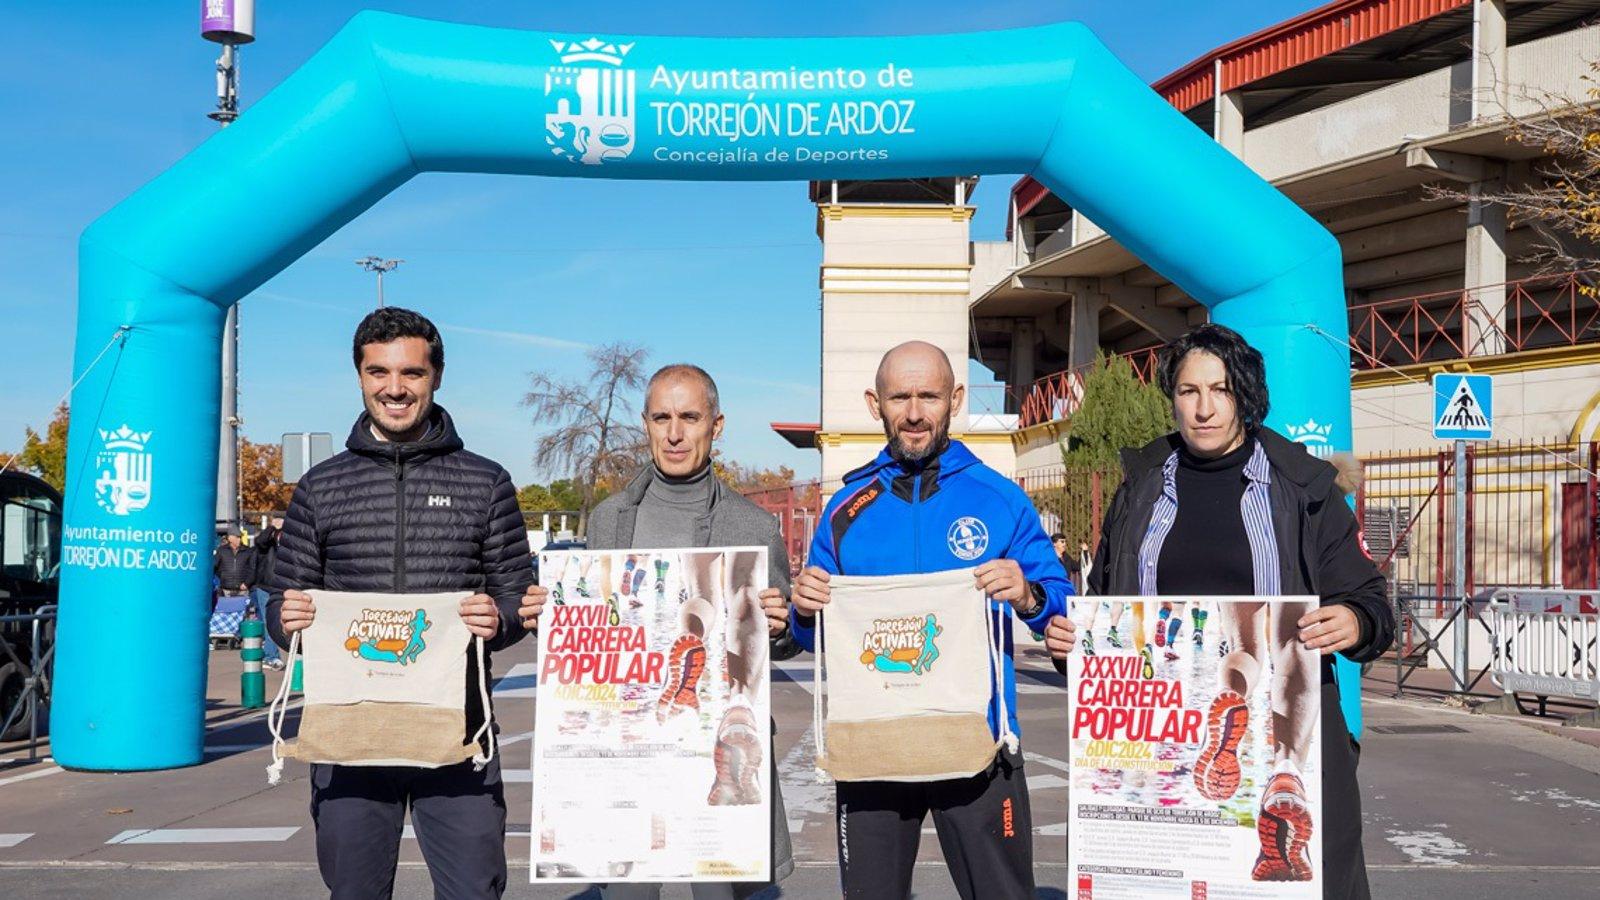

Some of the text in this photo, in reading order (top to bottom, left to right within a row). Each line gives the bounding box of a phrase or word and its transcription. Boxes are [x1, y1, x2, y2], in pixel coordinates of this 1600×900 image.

[649, 63, 913, 95] Ayuntamiento de
[649, 93, 915, 142] TORREJÓN DE ARDOZ
[653, 147, 888, 164] Concejalía de Deportes
[428, 495, 451, 506] HH
[65, 524, 198, 544] Ayuntamiento de
[63, 542, 197, 570] TORREJÓN DE ARDOZ
[550, 605, 609, 627] XXXVII
[547, 626, 647, 653] CARRERA
[540, 652, 664, 685] POPULAR
[1080, 656, 1143, 679] XXXVII
[1077, 679, 1183, 708] CARRERA
[1072, 707, 1203, 744] POPULAR
